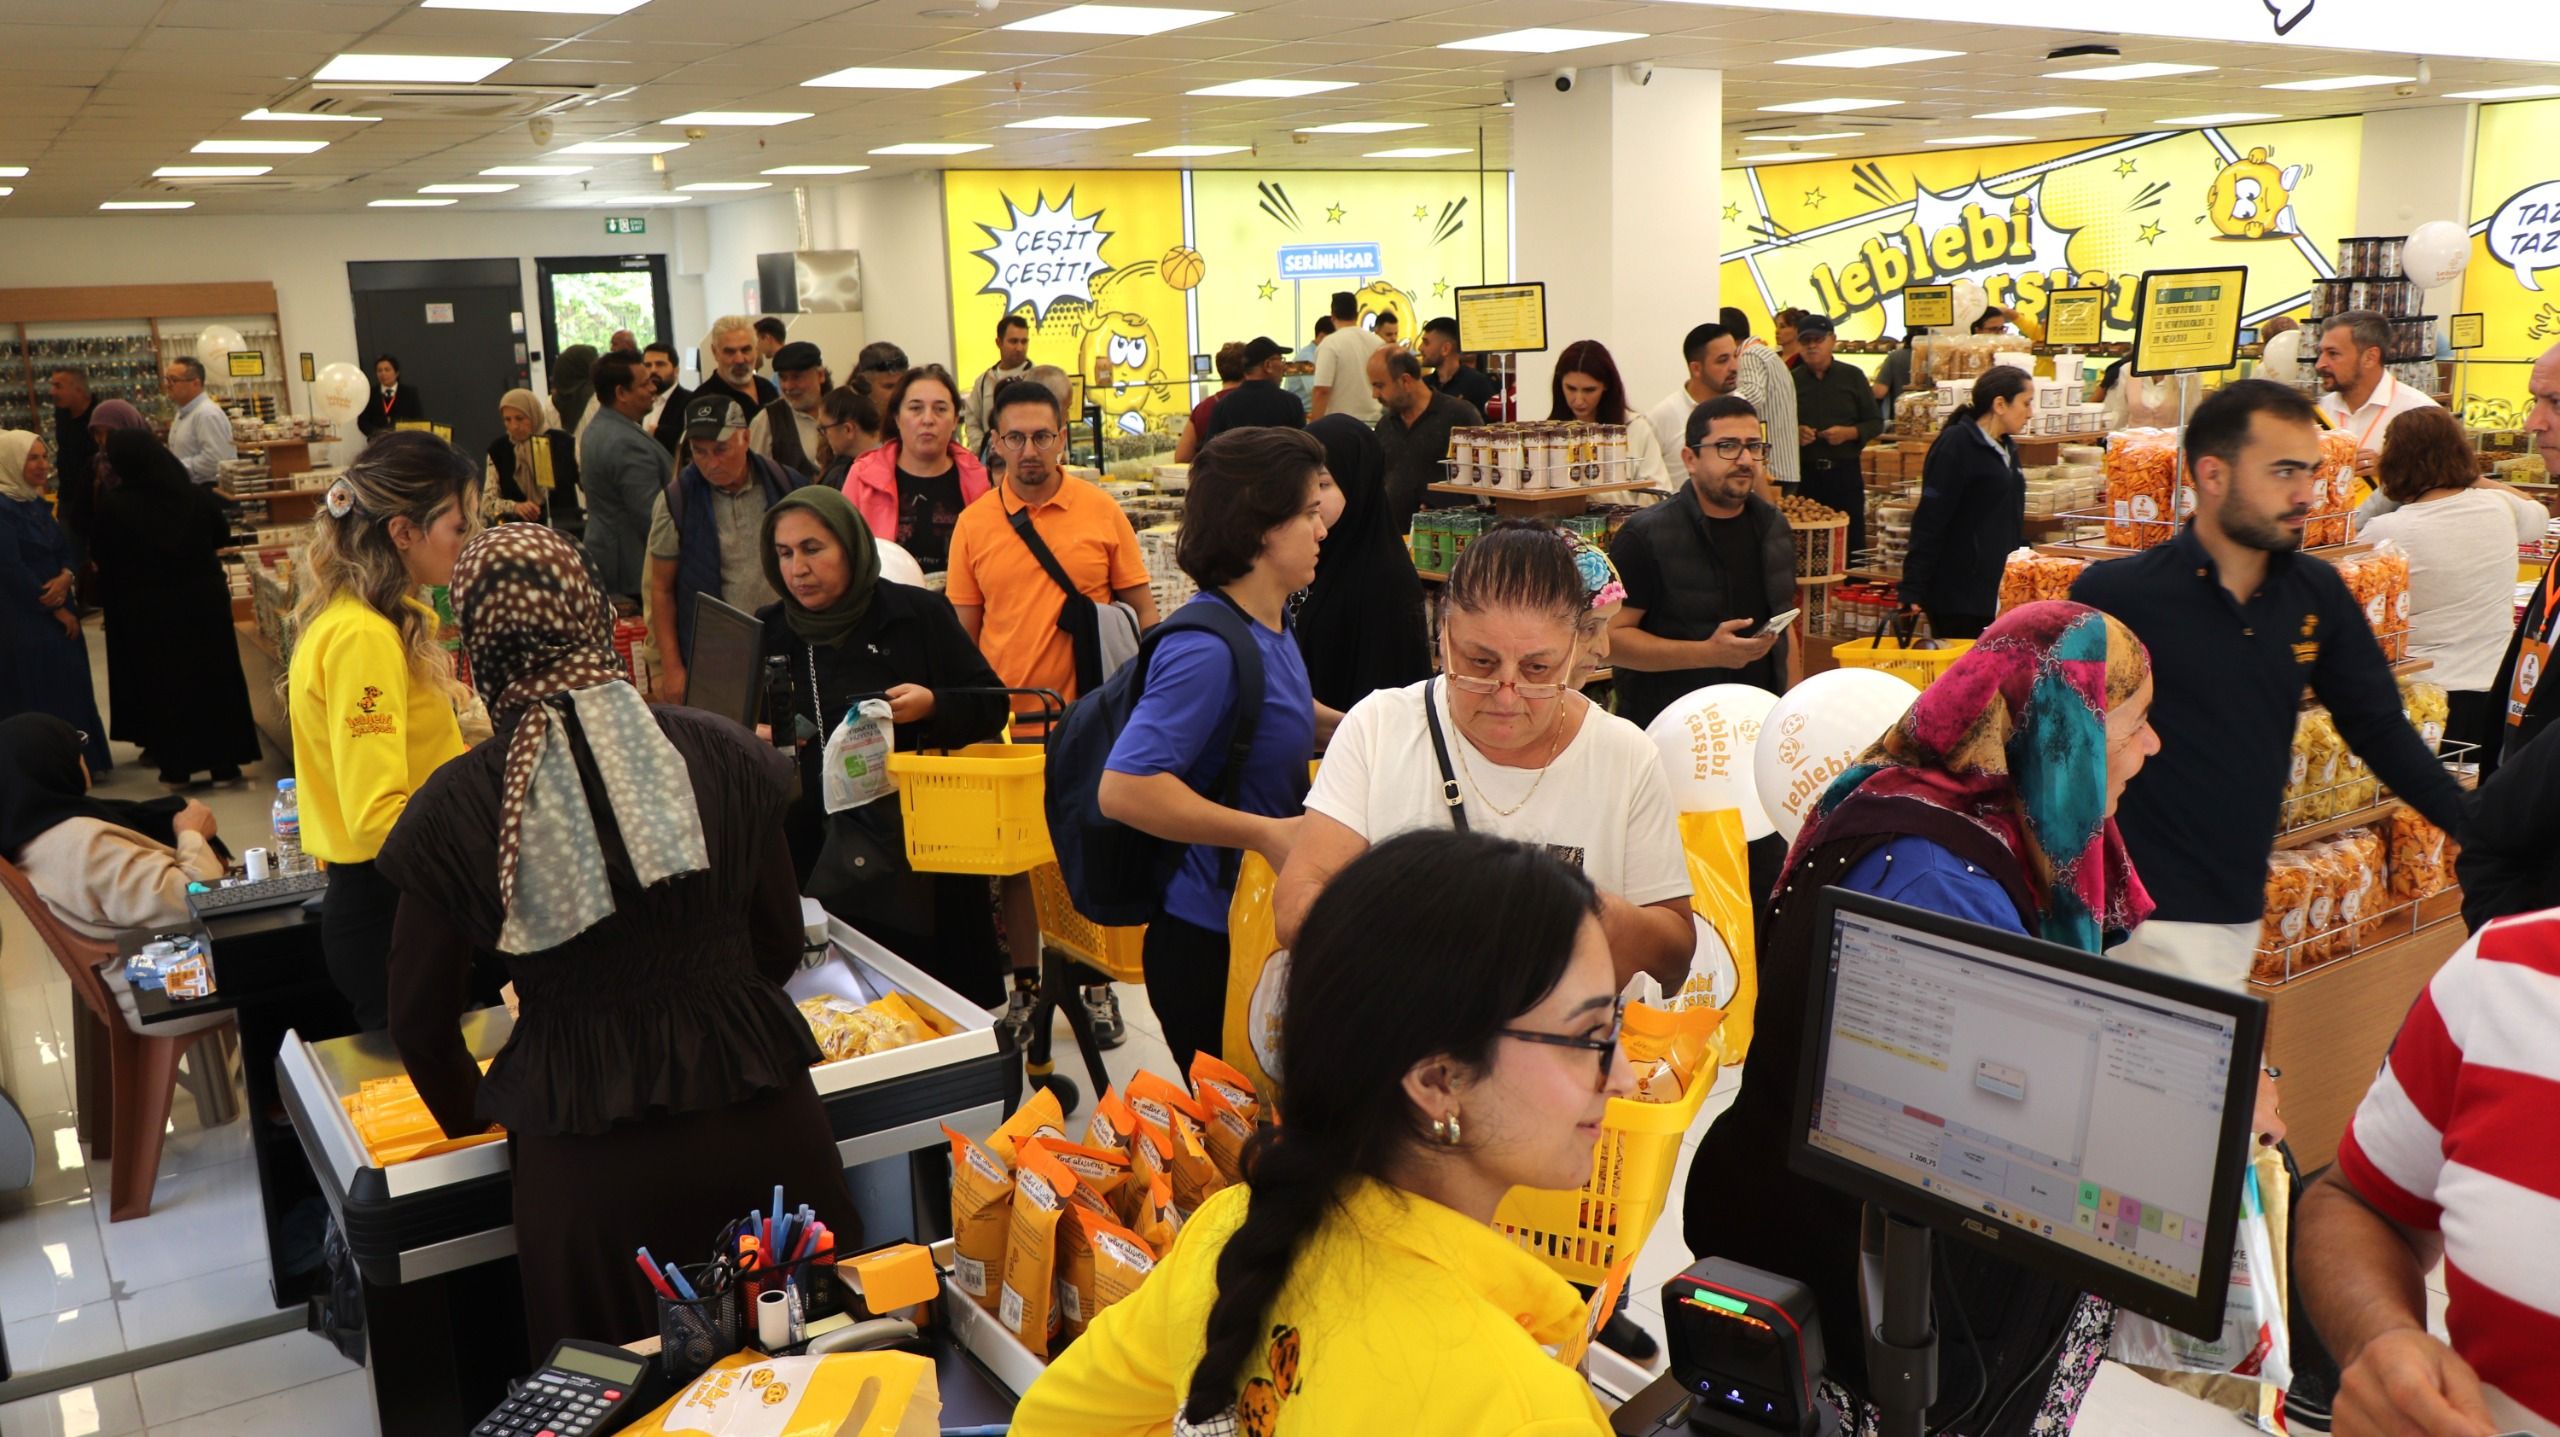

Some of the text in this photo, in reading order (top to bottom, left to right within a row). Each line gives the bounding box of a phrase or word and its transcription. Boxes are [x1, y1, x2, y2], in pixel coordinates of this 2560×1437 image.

[1015, 224, 1092, 255] ÇEŞİT
[1284, 248, 1375, 273] SERİNHİSAR
[1810, 192, 2037, 326] leblebi
[1005, 256, 1092, 288] ÇEŞİT!
[1684, 712, 1708, 781] çarşısı
[1702, 703, 1730, 777] leblebi
[1782, 751, 1852, 816] leblebi
[1960, 1217, 2000, 1240] ASUS
